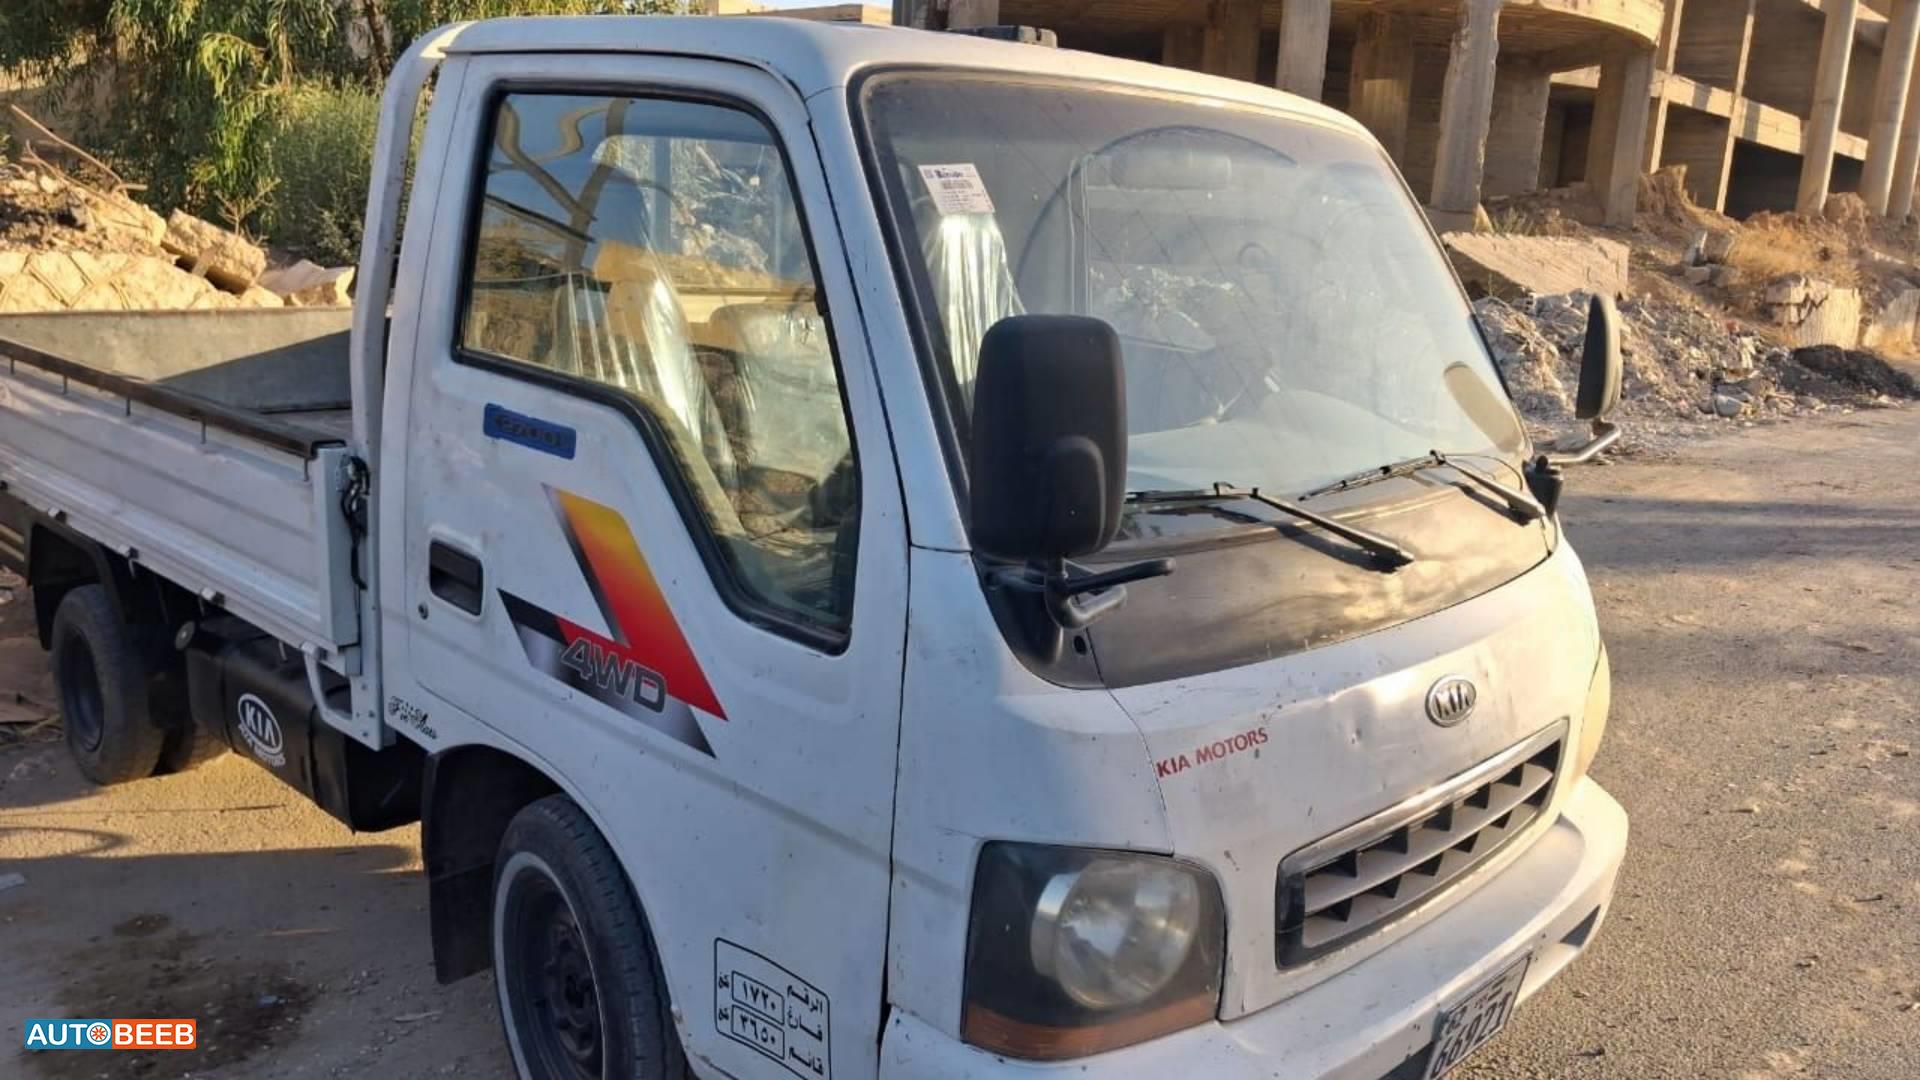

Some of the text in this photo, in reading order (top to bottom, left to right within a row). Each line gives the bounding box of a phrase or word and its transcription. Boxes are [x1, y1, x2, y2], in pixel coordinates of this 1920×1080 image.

[560, 637, 667, 713] 4WD
[244, 701, 277, 748] KIA
[1434, 684, 1470, 719] KIA
[1156, 727, 1270, 778] KIA MOTORS
[787, 1006, 823, 1041] فارغ
